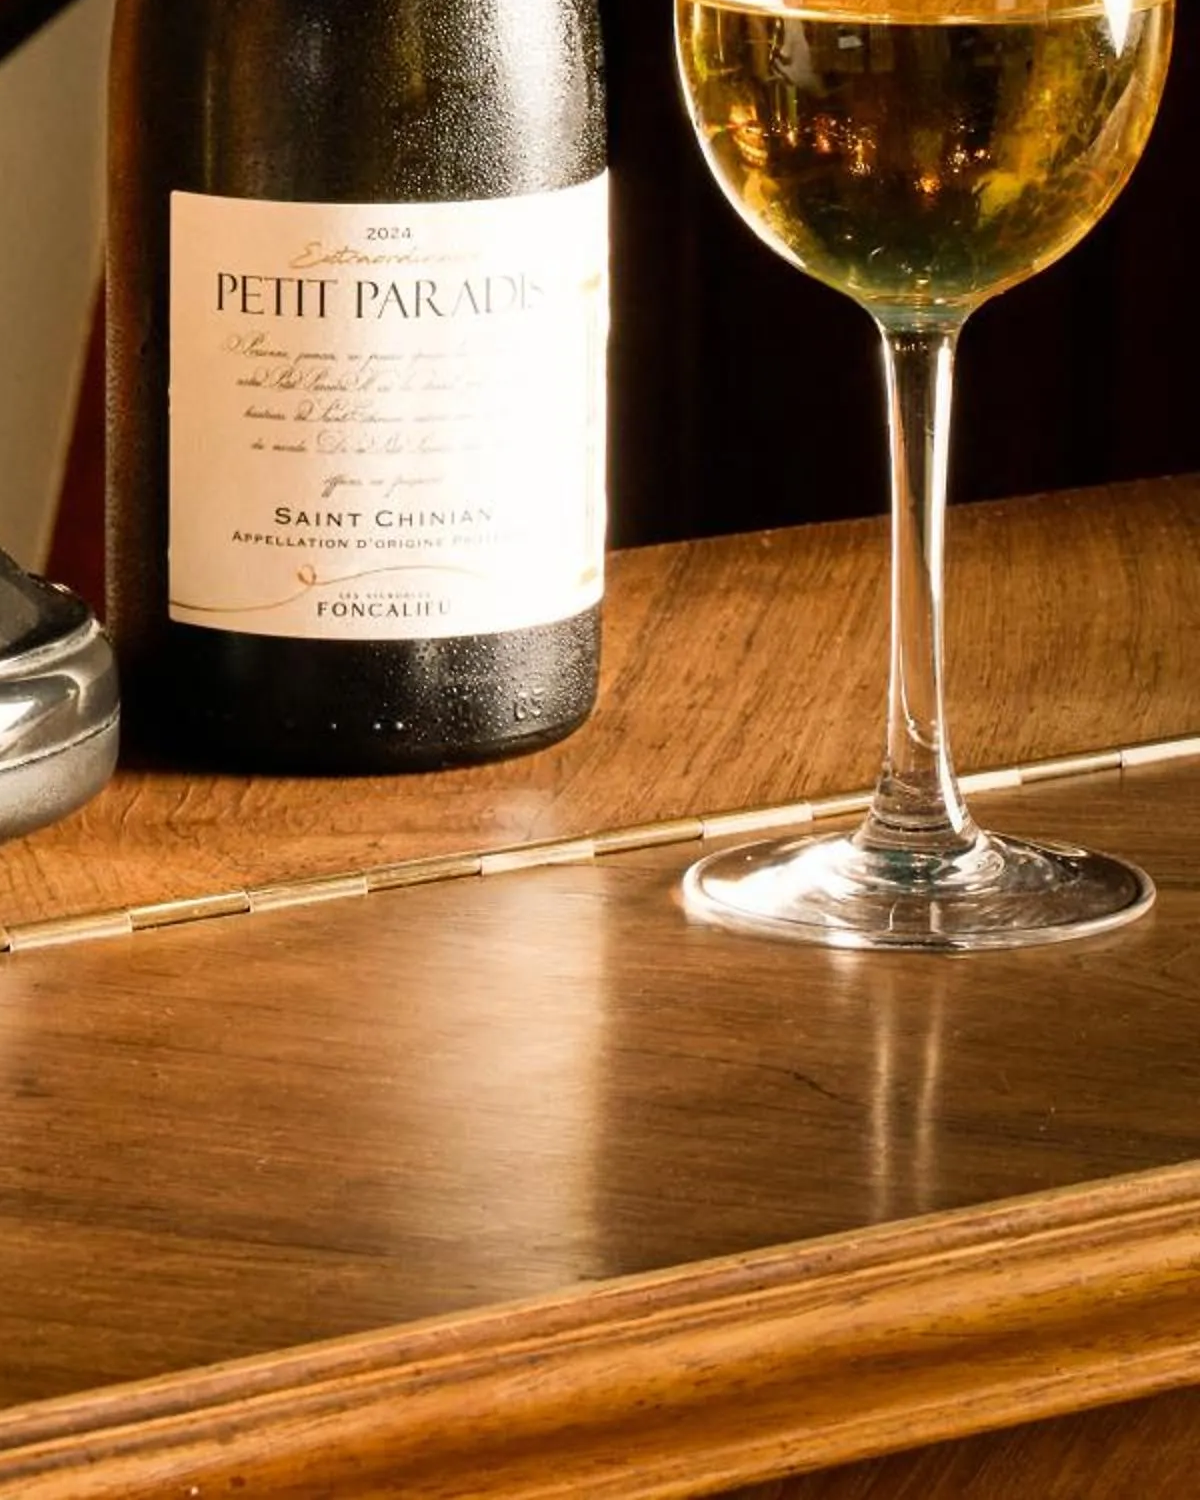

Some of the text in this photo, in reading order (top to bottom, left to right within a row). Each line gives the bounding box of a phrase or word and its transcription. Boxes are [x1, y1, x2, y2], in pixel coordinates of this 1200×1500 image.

[366, 226, 412, 241] 2024
[215, 272, 338, 319] PETIT
[274, 507, 495, 528] SAINT CHINIAN
[231, 530, 349, 549] APPELLATION
